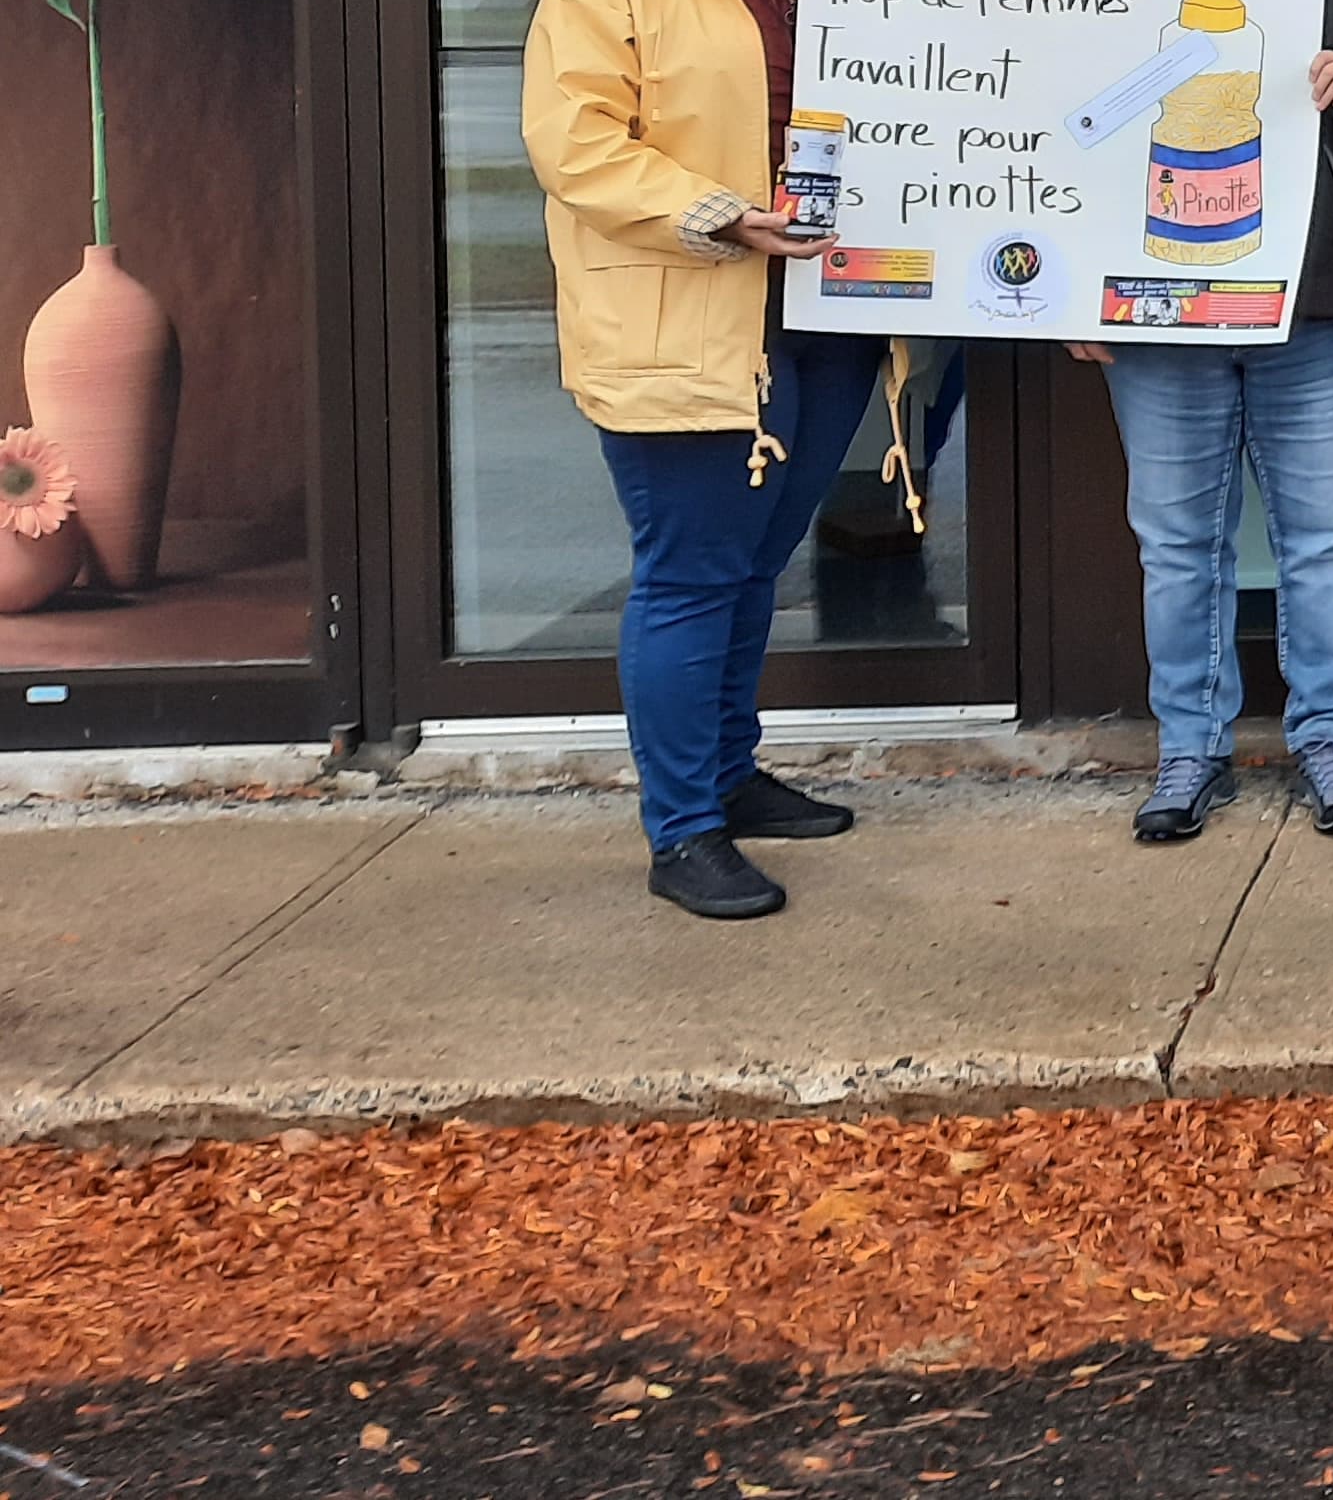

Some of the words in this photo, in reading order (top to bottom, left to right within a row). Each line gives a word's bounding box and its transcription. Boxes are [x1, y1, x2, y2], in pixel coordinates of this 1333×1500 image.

[812, 24, 1021, 100] Travaillent
[845, 116, 935, 145] core
[958, 127, 1051, 164] pour
[902, 165, 1083, 224] pinottes
[1183, 177, 1260, 214] Pinottes
